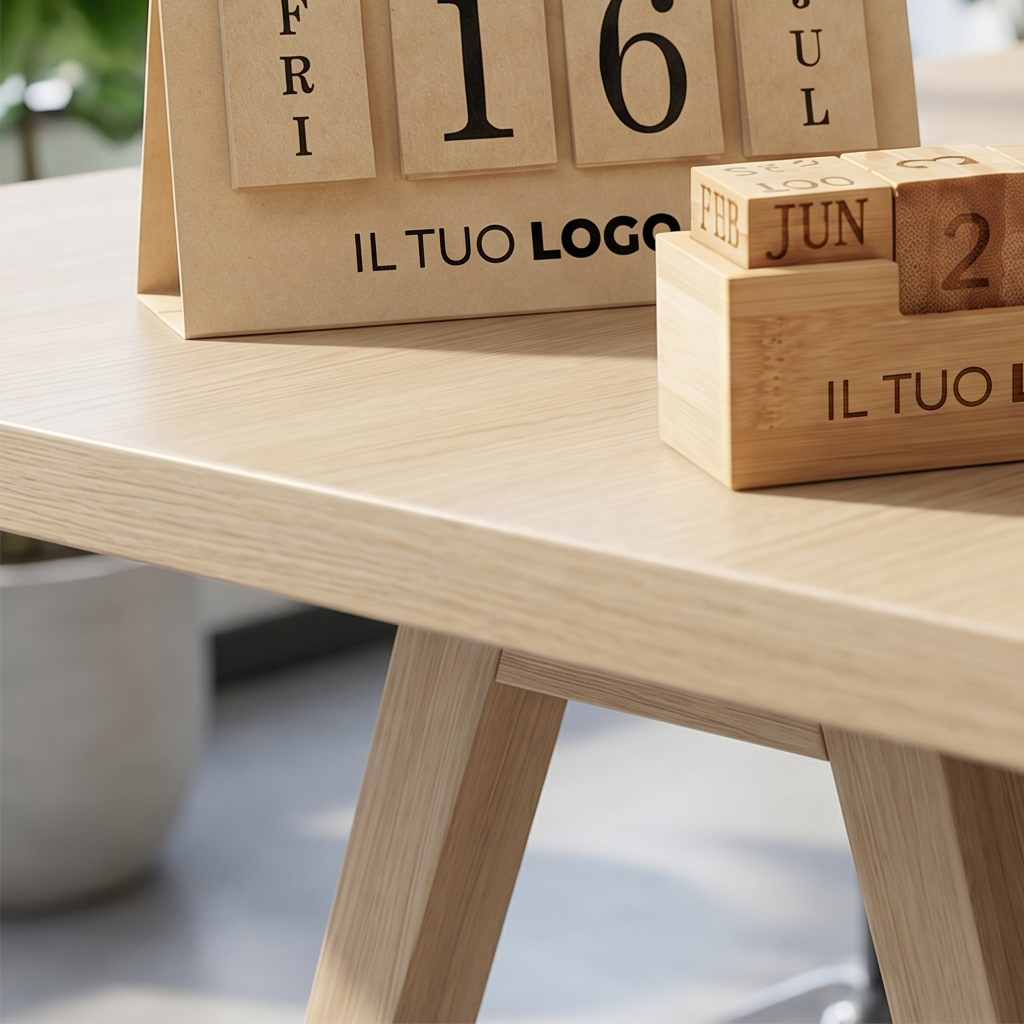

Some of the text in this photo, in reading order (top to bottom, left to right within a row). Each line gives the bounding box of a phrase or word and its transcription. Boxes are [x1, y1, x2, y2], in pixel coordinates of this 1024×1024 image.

[354, 212, 681, 273] IL TUO LOGO
[764, 197, 869, 262] JUN
[940, 211, 991, 291] 2
[827, 379, 869, 421] IL
[882, 366, 994, 415] TUO
